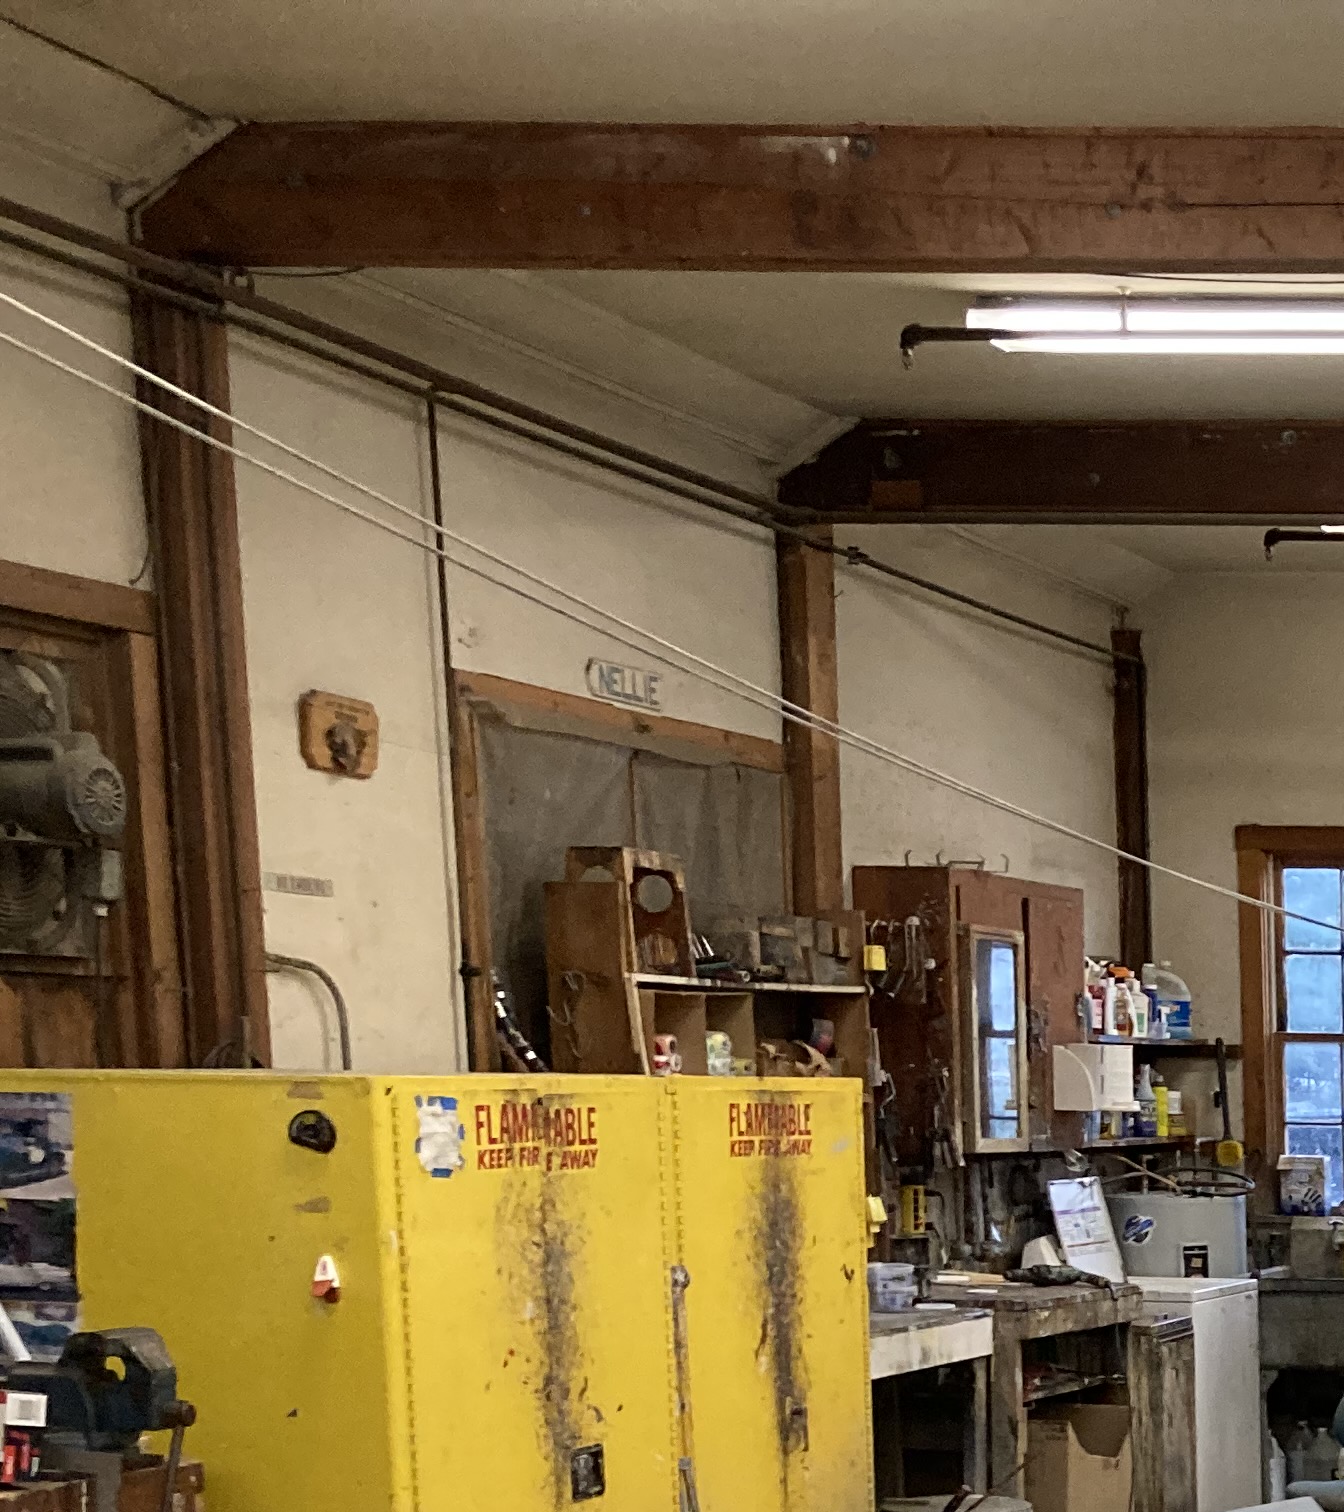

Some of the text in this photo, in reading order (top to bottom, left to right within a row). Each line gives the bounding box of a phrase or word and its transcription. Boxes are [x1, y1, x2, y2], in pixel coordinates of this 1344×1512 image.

[599, 664, 662, 706] NELLIE
[476, 1148, 514, 1171] KEEP
[559, 1148, 599, 1171] AWAY
